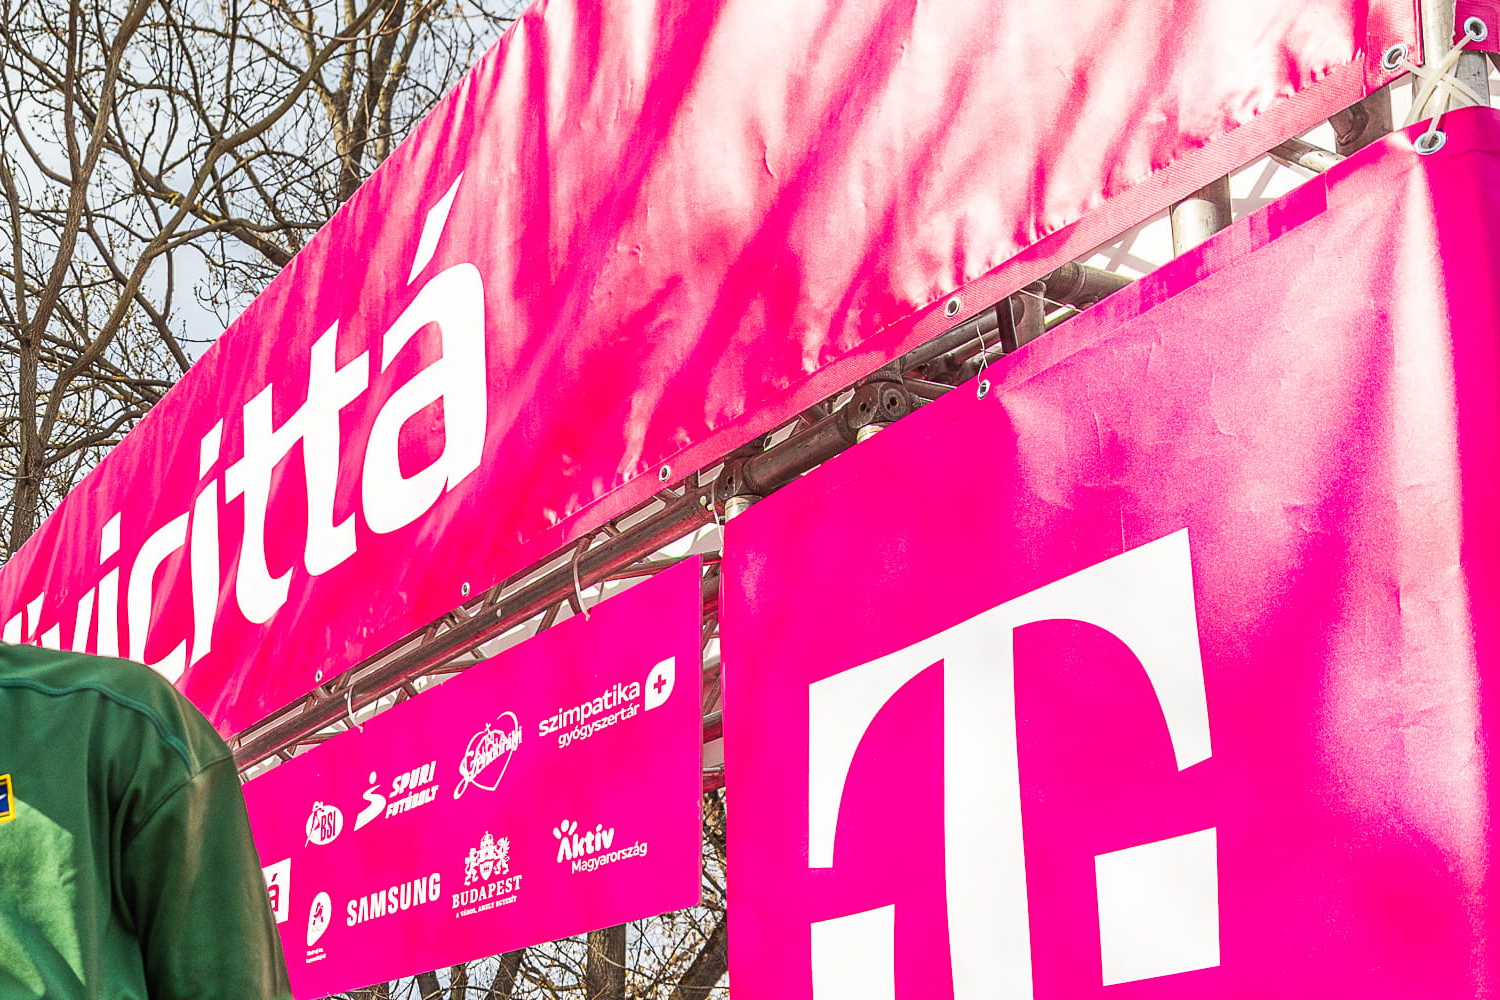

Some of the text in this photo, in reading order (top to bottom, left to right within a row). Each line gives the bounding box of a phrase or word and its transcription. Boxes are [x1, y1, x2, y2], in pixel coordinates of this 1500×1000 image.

[1, 170, 487, 684] icittá
[538, 681, 641, 737] szimpatika
[558, 702, 640, 749] gyógyszertár
[388, 760, 437, 799] SPURI
[320, 810, 336, 841] BSI
[571, 840, 648, 874] Magyarország
[346, 872, 441, 927] SAMSUNG
[451, 874, 523, 910] BUDAPEST
